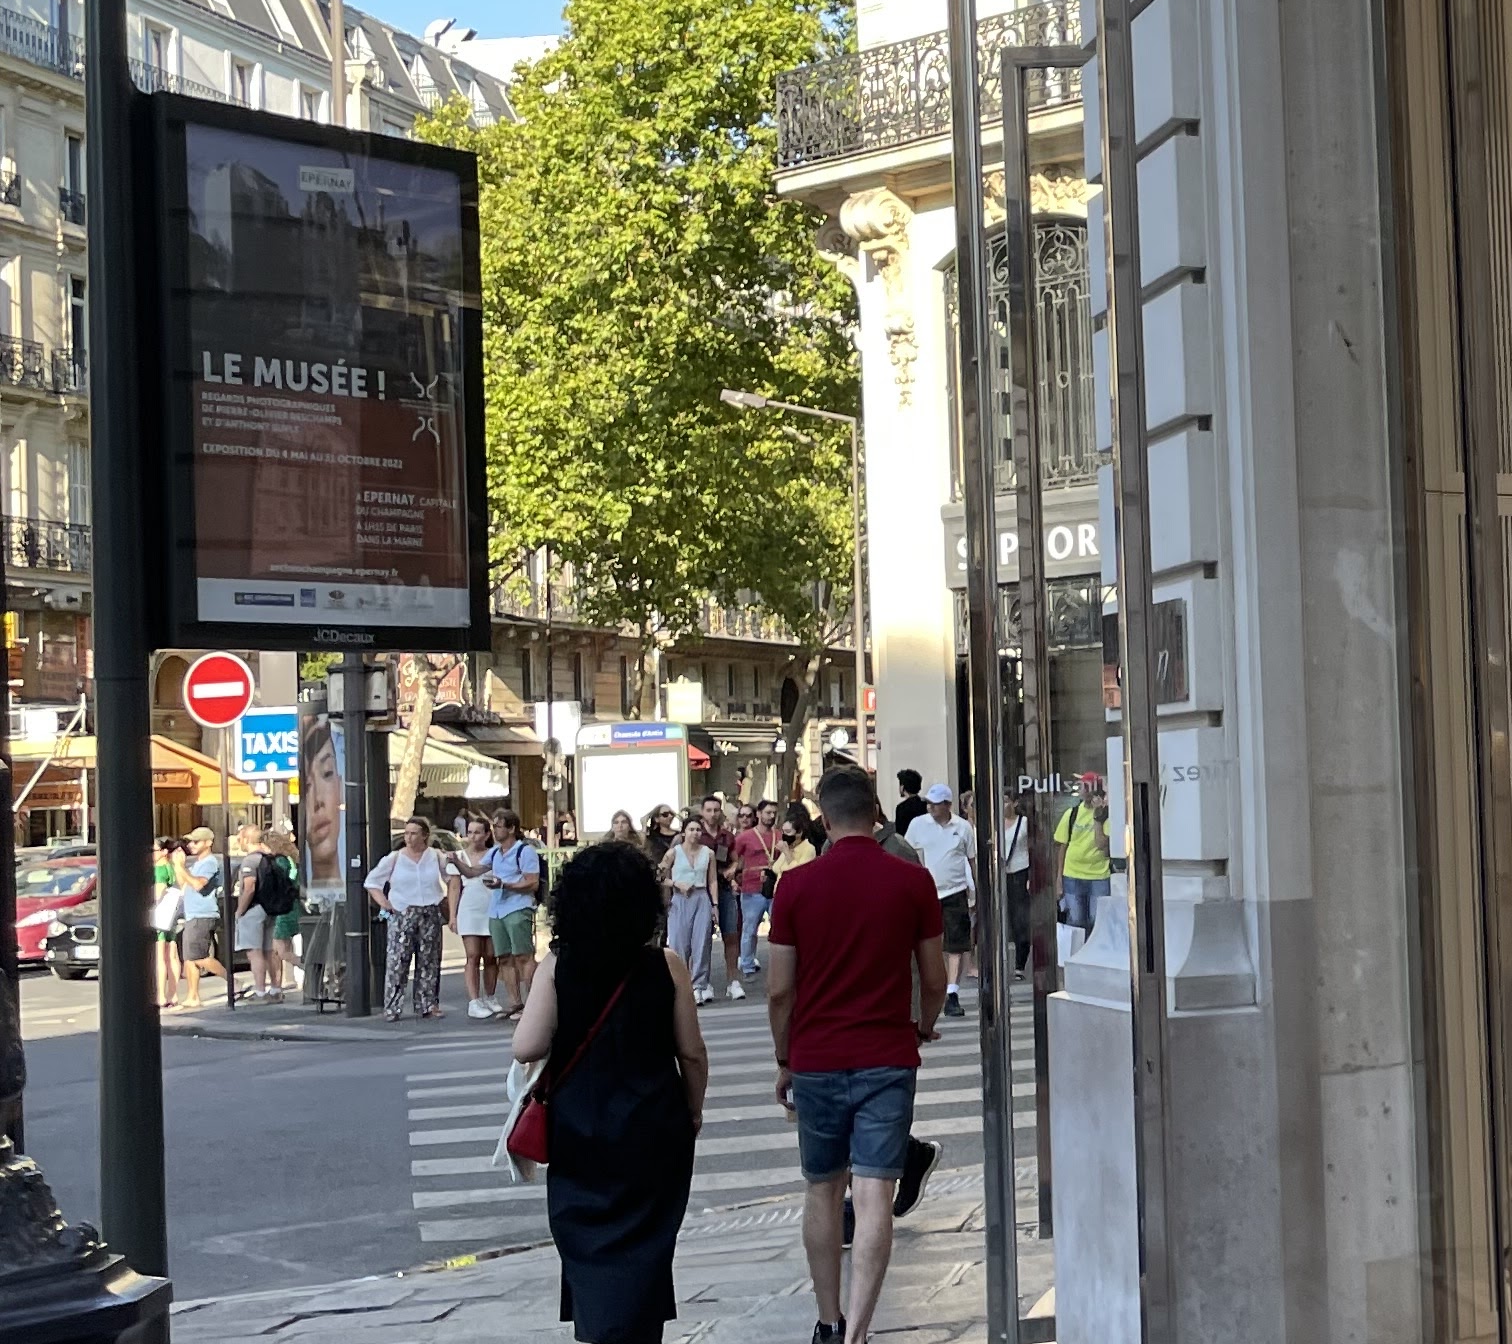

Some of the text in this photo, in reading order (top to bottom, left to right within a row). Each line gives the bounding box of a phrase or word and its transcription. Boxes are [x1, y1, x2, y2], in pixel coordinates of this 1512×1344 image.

[301, 171, 352, 189] EPERNAY
[202, 350, 386, 401] LE MUSÉE !
[201, 391, 336, 413] REGARDS PHOTOGRAPHIQUES
[203, 442, 262, 456] EXPOSITION
[265, 448, 280, 458] DU
[291, 450, 308, 461] MAI
[310, 452, 323, 462] AU
[337, 454, 380, 467] OCTOBRE
[363, 490, 416, 506] EPERNAY
[419, 497, 457, 509] CAPITALE
[356, 505, 425, 520] DU CHAMPAGNE
[386, 522, 397, 533] DE
[399, 523, 423, 534] PARIS
[356, 533, 423, 547] DANS LA MARNE
[313, 627, 375, 644] JCDecaux
[242, 730, 299, 755] TAXIS
[1018, 773, 1061, 794] Pull
